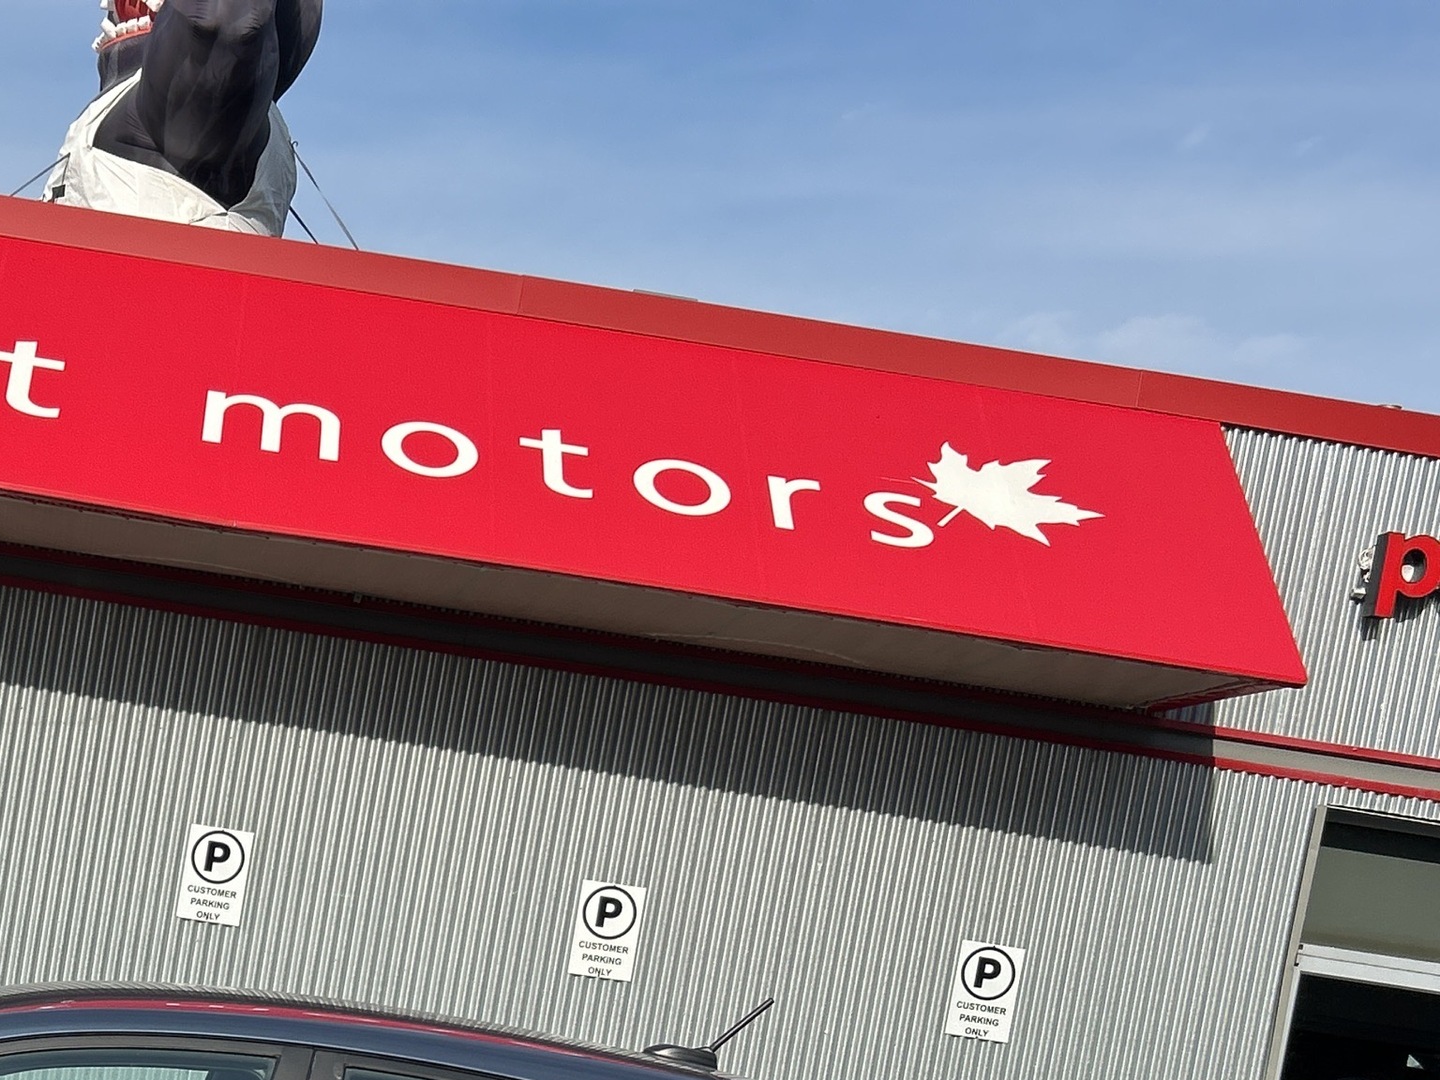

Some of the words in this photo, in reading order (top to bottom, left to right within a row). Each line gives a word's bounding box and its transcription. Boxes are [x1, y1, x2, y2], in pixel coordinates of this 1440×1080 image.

[201, 389, 934, 549] motors
[204, 840, 231, 872] P
[187, 884, 237, 899] CUSTOMER
[190, 897, 230, 910] PARKING
[196, 911, 220, 921] ONLY
[595, 896, 623, 928] P
[578, 940, 629, 955] CUSTOMER
[581, 953, 622, 966] PARKING
[588, 966, 612, 977] ONLY
[973, 956, 1002, 988] P
[956, 1000, 1007, 1016] CUSTOMER
[959, 1013, 1000, 1027] PARKING
[964, 1027, 990, 1037] ONLY
